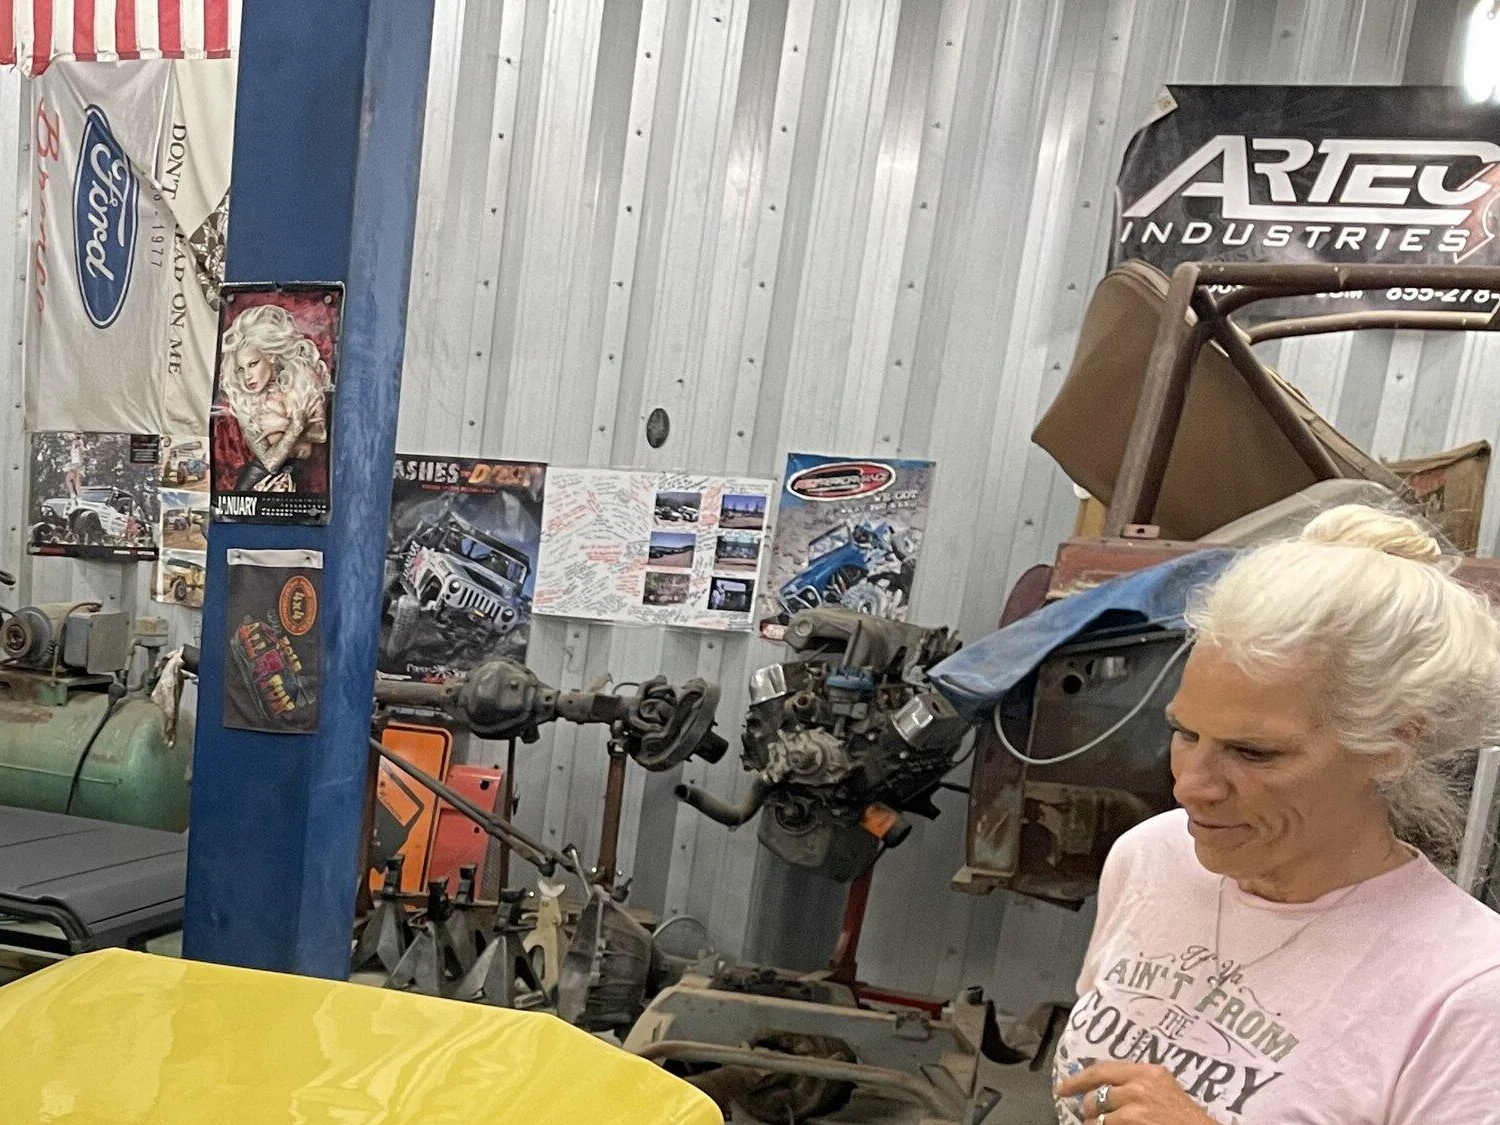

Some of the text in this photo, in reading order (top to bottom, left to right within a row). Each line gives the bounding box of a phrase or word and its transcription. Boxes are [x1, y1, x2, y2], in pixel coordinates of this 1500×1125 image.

[161, 122, 187, 200] DON'T
[85, 142, 131, 282] Ford
[150, 225, 165, 269] 1977
[1119, 220, 1474, 253] INDUSTRIES
[169, 292, 187, 328] ON
[168, 338, 183, 375] ME
[393, 458, 460, 484] ASHES
[1103, 958, 1300, 1063] AIN'T FROM
[1157, 1008, 1195, 1040] THE
[1070, 988, 1285, 1116] COUNTRY
